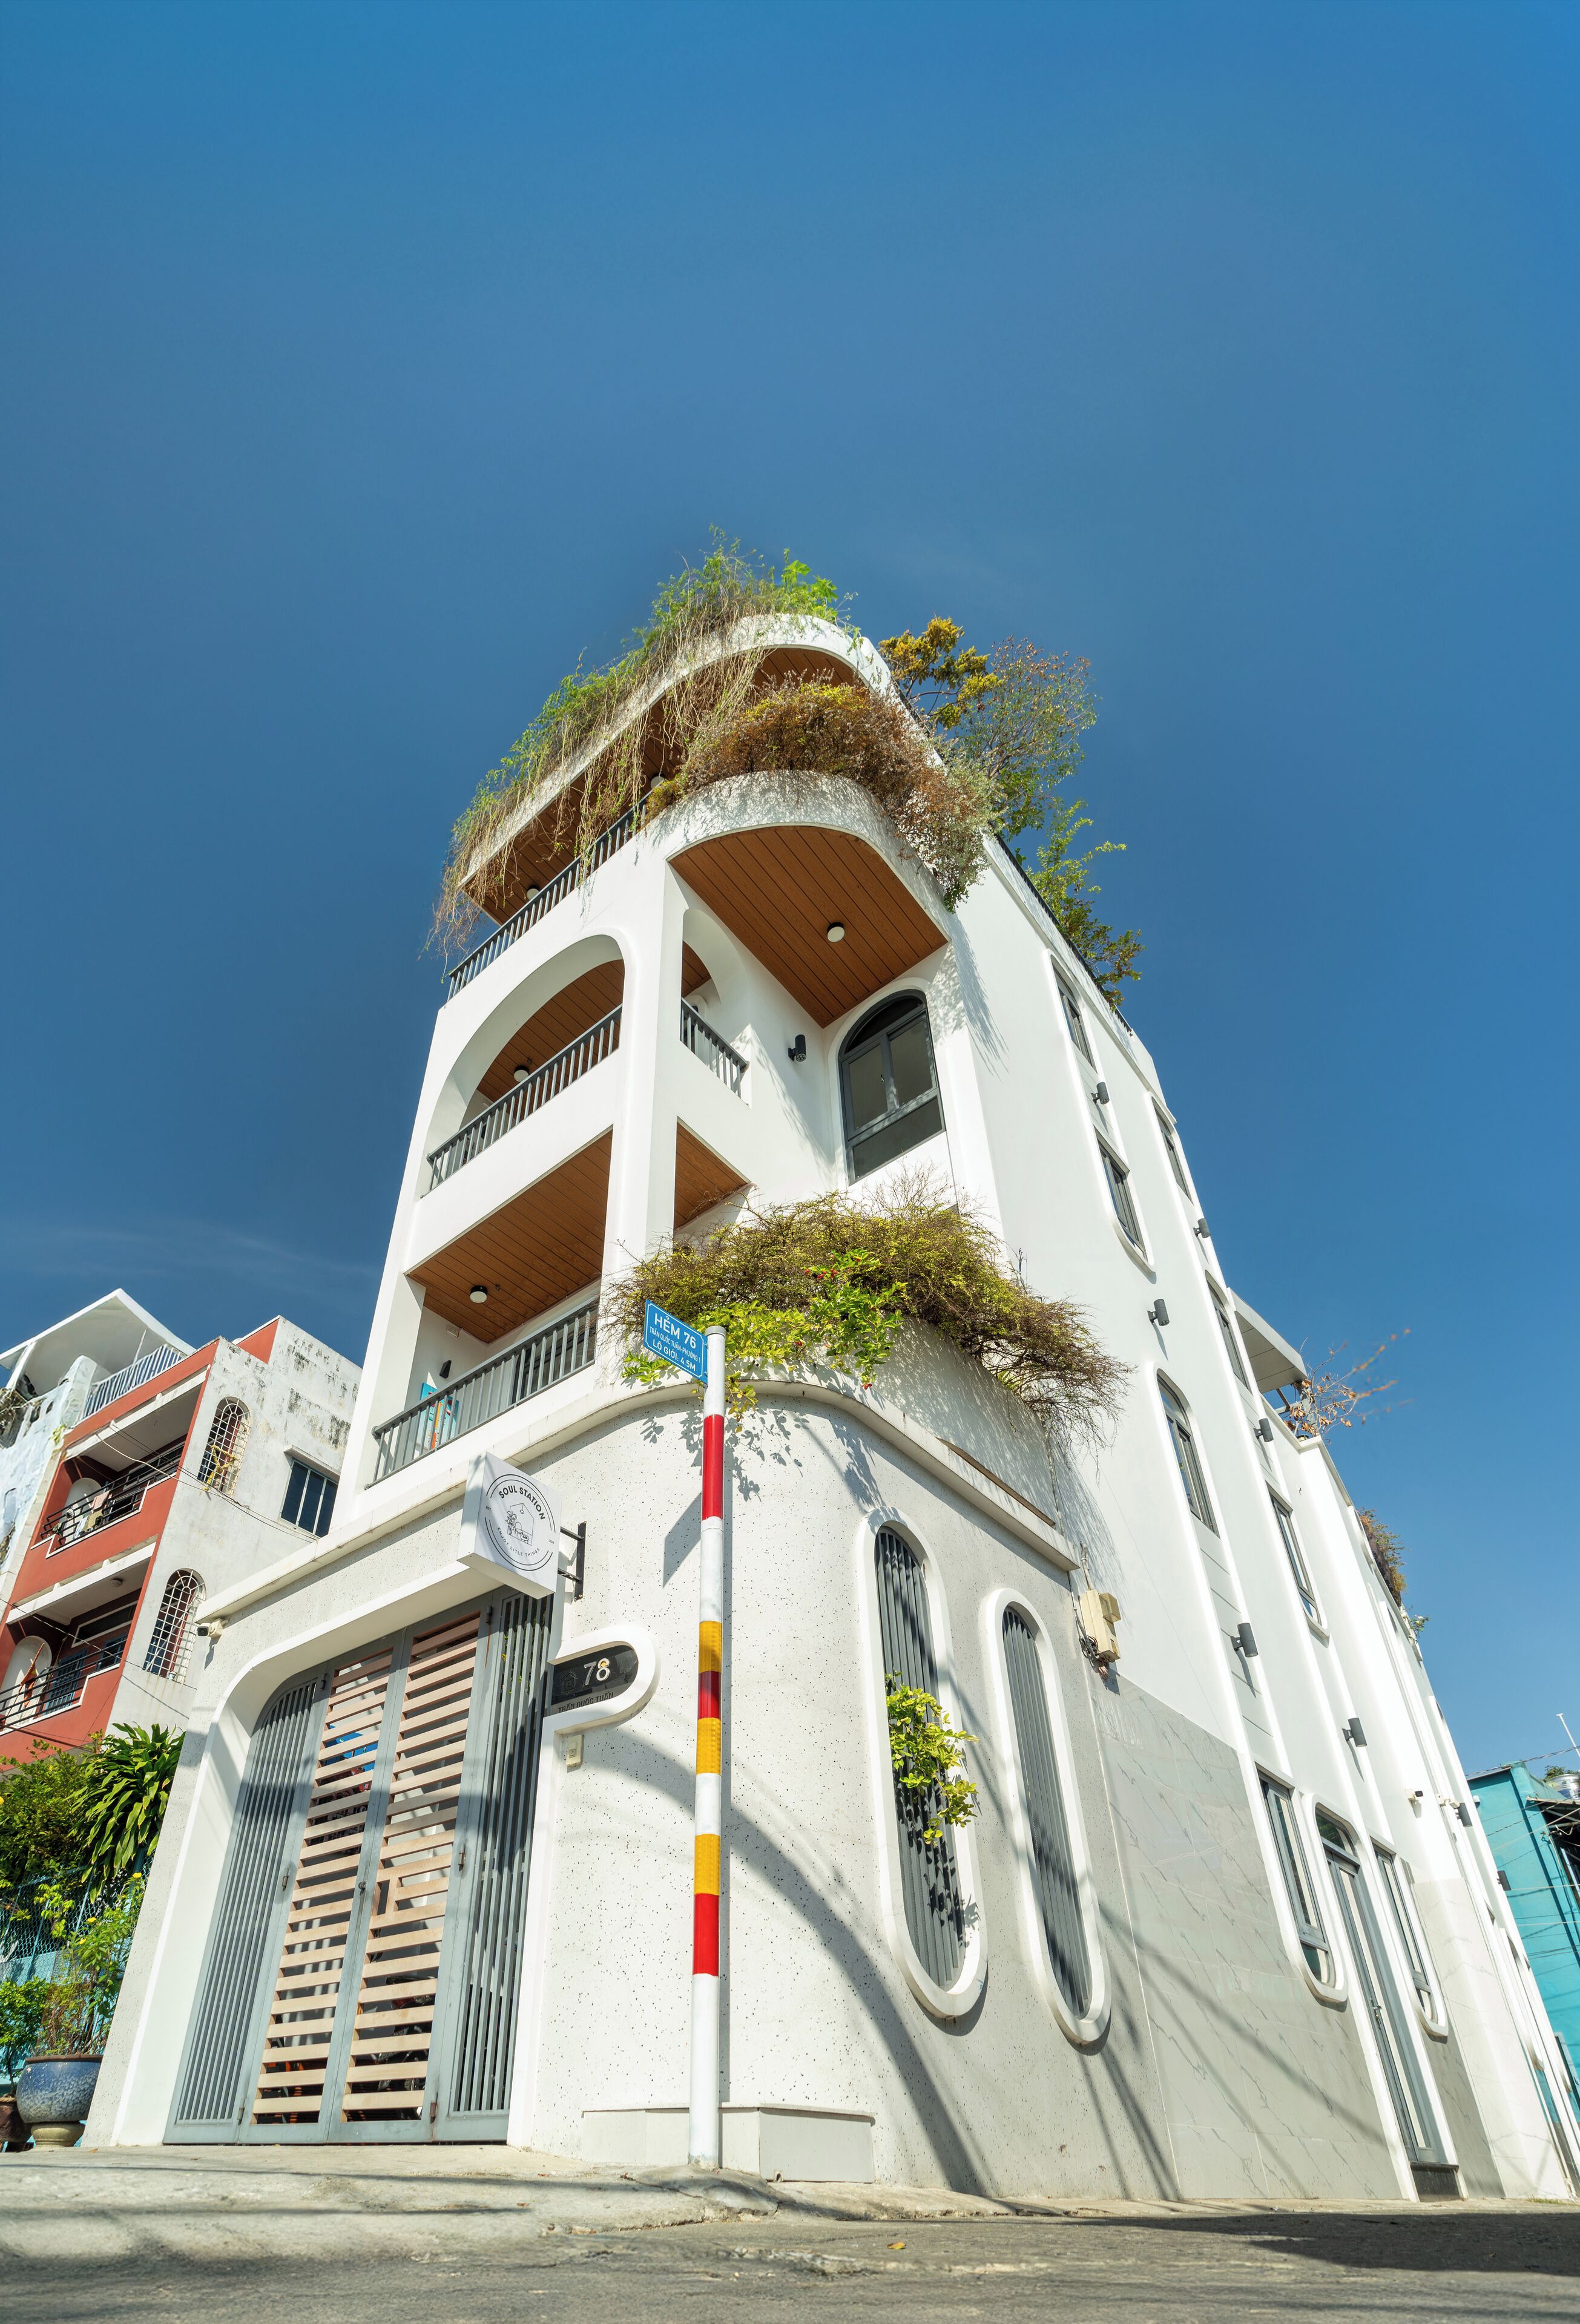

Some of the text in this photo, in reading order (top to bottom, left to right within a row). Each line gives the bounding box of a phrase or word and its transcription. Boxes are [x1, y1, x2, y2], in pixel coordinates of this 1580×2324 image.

[654, 1313, 696, 1349] HẺM 76
[660, 1333, 671, 1345] QUỐC
[653, 1339, 696, 1371] LỘ GIỚI: 4.5M
[499, 1485, 545, 1520] SOUL STATION
[497, 1527, 540, 1557] ENJOY LITLE THINGS
[584, 1658, 610, 1686] 78
